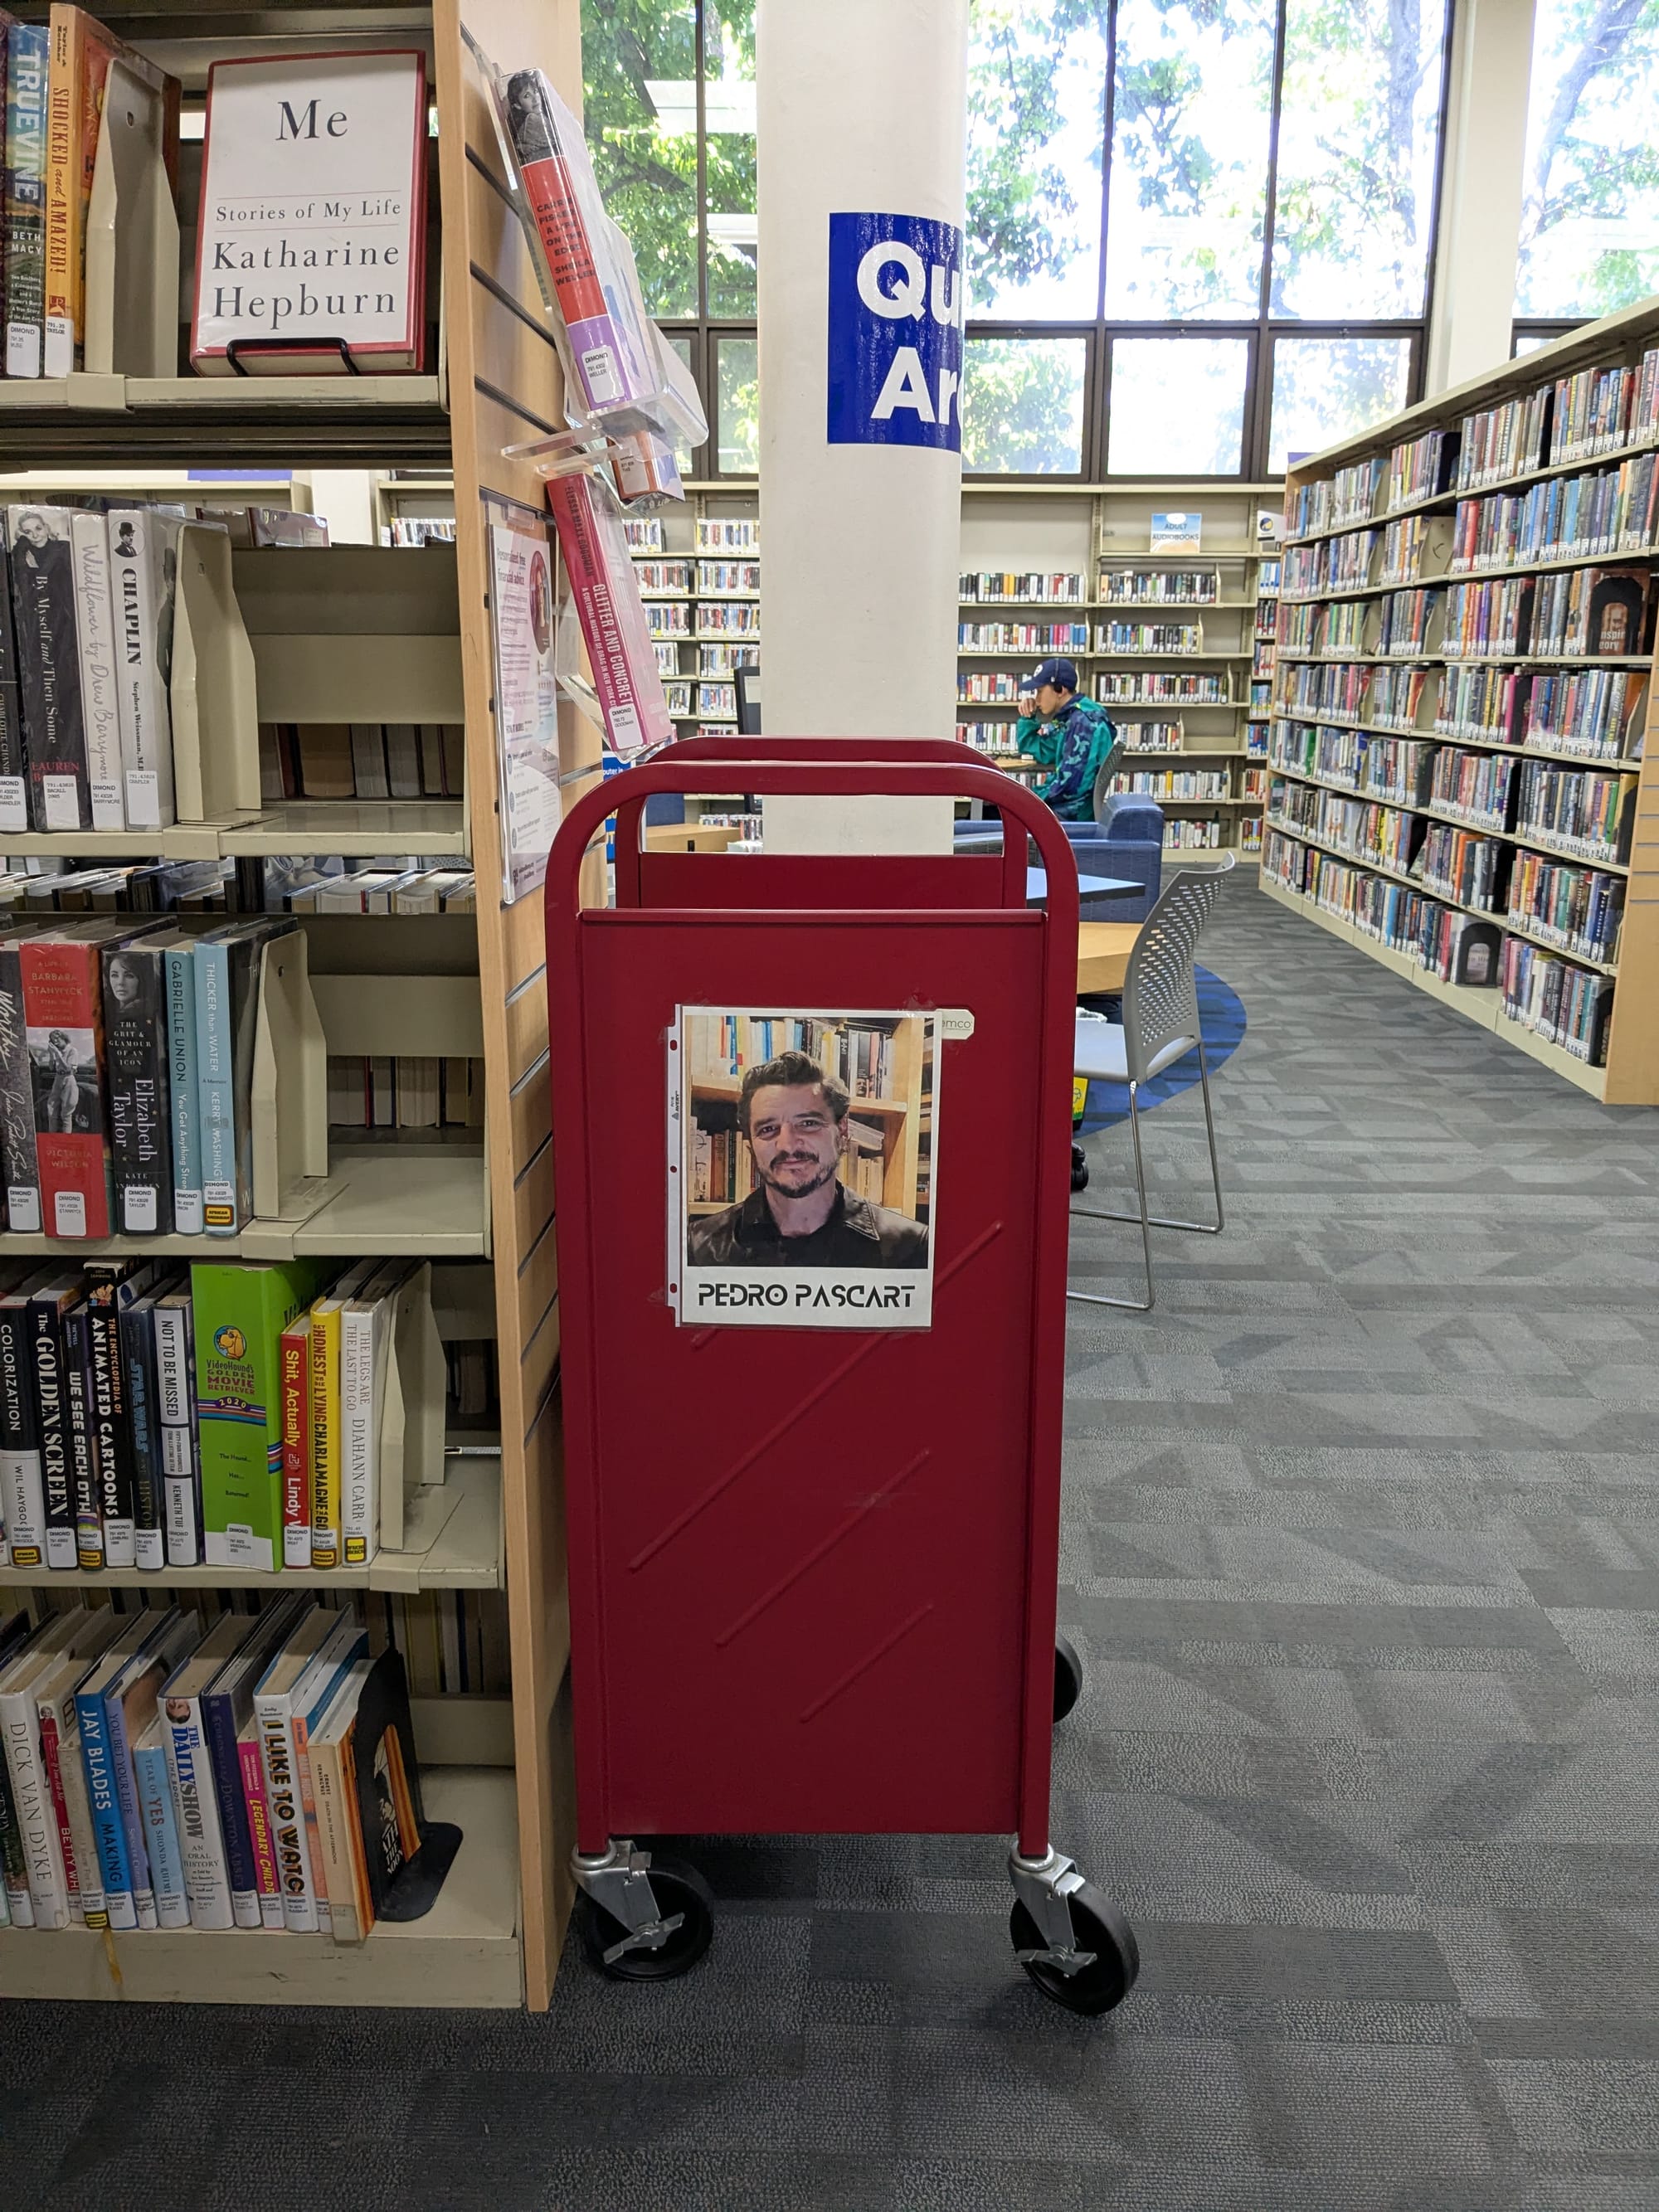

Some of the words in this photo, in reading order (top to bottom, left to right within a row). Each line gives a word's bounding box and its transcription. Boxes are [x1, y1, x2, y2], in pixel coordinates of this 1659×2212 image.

[15, 53, 41, 200] TRUEVINE
[51, 87, 69, 164] SHOCKED
[275, 99, 348, 141] Me
[55, 168, 66, 197] and
[216, 205, 285, 221] Stories
[295, 202, 315, 219] of
[324, 202, 352, 221] My
[361, 199, 401, 216] Life
[12, 231, 41, 241] BETH
[12, 243, 41, 255] MACY
[50, 198, 67, 274] AMAZED!
[212, 240, 399, 270] Katharine
[554, 258, 591, 275] SHEILA
[857, 241, 961, 330] Qu
[212, 283, 396, 330] Hepburn
[11, 326, 35, 335] DIMOND
[585, 352, 608, 363] DIMOND
[588, 369, 606, 379] WELLER
[32, 576, 48, 591] By
[79, 544, 106, 636] Wildflower
[35, 597, 53, 642] Myself
[122, 568, 142, 666] CHAPLIN
[592, 583, 613, 628] GLITTER
[41, 643, 54, 664] and
[85, 641, 107, 659] by
[604, 630, 621, 654] AND
[43, 666, 56, 702] Then
[90, 663, 109, 705] Drew
[132, 680, 140, 712] Stephen
[610, 655, 634, 705] CONCRET
[46, 706, 59, 744] Some
[611, 707, 632, 717] DIMOND
[90, 708, 114, 781] Barrymore
[134, 713, 144, 756] Weissman,
[32, 761, 79, 771] LAUREN
[32, 972, 78, 982] BARBARA
[206, 962, 217, 1011] THICKER
[171, 960, 186, 1034] GABRIELLE
[207, 1013, 217, 1033] than
[109, 1039, 152, 1048] GLAMOUR
[174, 1038, 187, 1082] UNION
[208, 1035, 219, 1072] WATER
[119, 1058, 143, 1067] ICON
[178, 1094, 187, 1111] You
[212, 1091, 221, 1125] KERRY
[110, 1091, 134, 1148] Taylor
[135, 1077, 158, 1162] Elizabeth
[179, 1112, 188, 1128] Got
[178, 1130, 191, 1166] Anything
[698, 1283, 788, 1306] PEDRO
[795, 1285, 915, 1308] PASCART
[37, 1312, 48, 1333] The
[108, 1318, 117, 1335] THE
[161, 1320, 174, 1342] NOT
[347, 1324, 358, 1346] THE
[163, 1344, 176, 1361] TO
[313, 1329, 327, 1377] HONEST
[360, 1330, 371, 1353] THE
[1, 1324, 22, 1432] COLORIZATION
[92, 1317, 111, 1417] ANIMATED
[109, 1338, 121, 1402] ENCYCLOPEDIA
[164, 1361, 177, 1374] BE
[207, 1359, 255, 1373] VideoHound's
[207, 1369, 255, 1380] GOLDEN
[285, 1350, 299, 1383] Shit,
[346, 1349, 358, 1376] LAST
[360, 1354, 371, 1383] LEGS
[36, 1336, 61, 1428] GOLDEN
[69, 1371, 83, 1397] WE
[129, 1358, 145, 1406] STAR
[165, 1377, 179, 1417] MISSED
[207, 1374, 255, 1388] MOVIE
[208, 1384, 255, 1395] RETRIEVER
[347, 1378, 358, 1393] TO
[359, 1385, 371, 1405] ARE
[71, 1400, 85, 1431] SEE
[114, 1403, 123, 1415] OF
[219, 1398, 246, 1408] 2020
[285, 1388, 301, 1446] Actually
[314, 1387, 328, 1422] LYING
[346, 1395, 358, 1411] GO
[133, 1406, 148, 1453] WARS
[74, 1434, 88, 1476] EACH
[314, 1422, 329, 1510] CHARLAMAGNE
[352, 1418, 366, 1481] DIAHANN
[15, 1465, 23, 1484] WIL
[44, 1432, 69, 1517] SCREEN
[99, 1422, 119, 1516] CARTOONS
[77, 1480, 91, 1513] OTH
[173, 1485, 183, 1516] KENNETH
[285, 1477, 302, 1517] Lindy
[352, 1485, 365, 1521] CARR
[81, 1710, 101, 1739] JAY
[109, 1713, 120, 1736] YOU
[188, 1724, 201, 1750] THE
[262, 1719, 284, 1729] I
[10, 1721, 35, 1772] DICK
[114, 1738, 124, 1758] BET
[171, 1725, 197, 1785] DAILY
[264, 1733, 292, 1785] LIKE
[87, 1747, 112, 1810] BLADES
[115, 1760, 129, 1791] YOUR
[145, 1757, 154, 1783] YEAR
[318, 1763, 326, 1796] HEMINGWAY
[21, 1780, 41, 1821] VAN
[120, 1790, 134, 1816] LIFE
[150, 1783, 158, 1795] OF
[271, 1787, 295, 1821] TO
[148, 1796, 165, 1827] YES
[180, 1783, 205, 1840] SHOW
[220, 1784, 240, 1846] DOWNTON
[250, 1799, 269, 1856] LEGENDARY
[29, 1830, 52, 1881] DYKE
[61, 1827, 75, 1869] BETTY
[100, 1823, 123, 1884] MAKING
[155, 1830, 168, 1865] SHONDA
[183, 1860, 220, 1868] HISTORY
[277, 1823, 305, 1895] WATC
